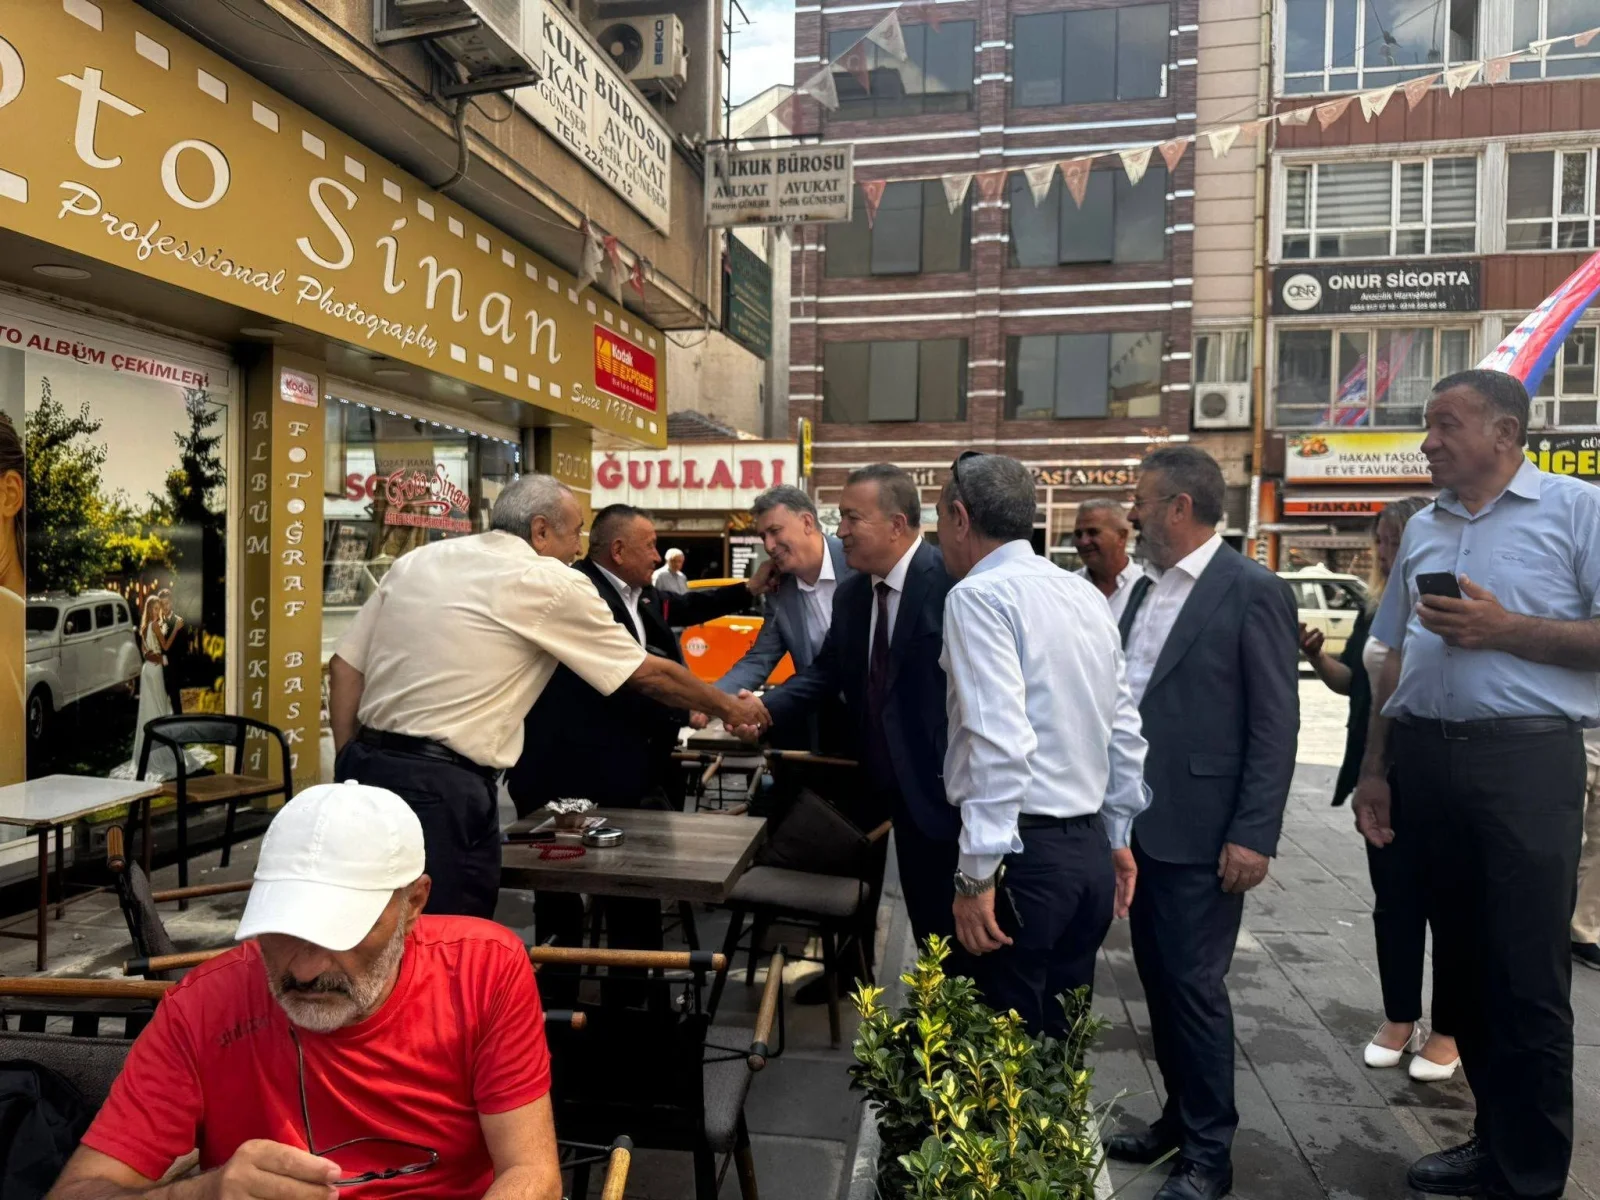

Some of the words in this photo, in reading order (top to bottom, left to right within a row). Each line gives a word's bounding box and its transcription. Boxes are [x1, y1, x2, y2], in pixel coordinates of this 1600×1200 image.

[540, 83, 587, 137] GÜNEŞER
[594, 69, 666, 165] BÜROSU
[584, 144, 604, 171] 224
[606, 164, 619, 183] 77
[622, 180, 633, 198] 12
[603, 117, 665, 192] AVUKAT
[777, 152, 845, 174] BÜROSU
[784, 179, 840, 194] AVUKAT
[58, 180, 286, 296] Professional
[296, 275, 438, 358] Photography
[296, 177, 562, 364] Sinan
[1328, 273, 1382, 289] ONUR
[1386, 269, 1471, 287] SİGORTA
[27, 334, 106, 364] ALBÜM
[111, 354, 210, 388] ÇEKİMLERİ
[612, 343, 634, 367] Kodak
[286, 379, 314, 396] Kodak
[1325, 465, 1338, 475] ET
[1341, 465, 1356, 475] VE
[1360, 464, 1397, 475] TAVUK
[1340, 452, 1380, 462] HAKAN
[430, 463, 470, 513] Sinan
[1307, 502, 1371, 512] HAKAN
